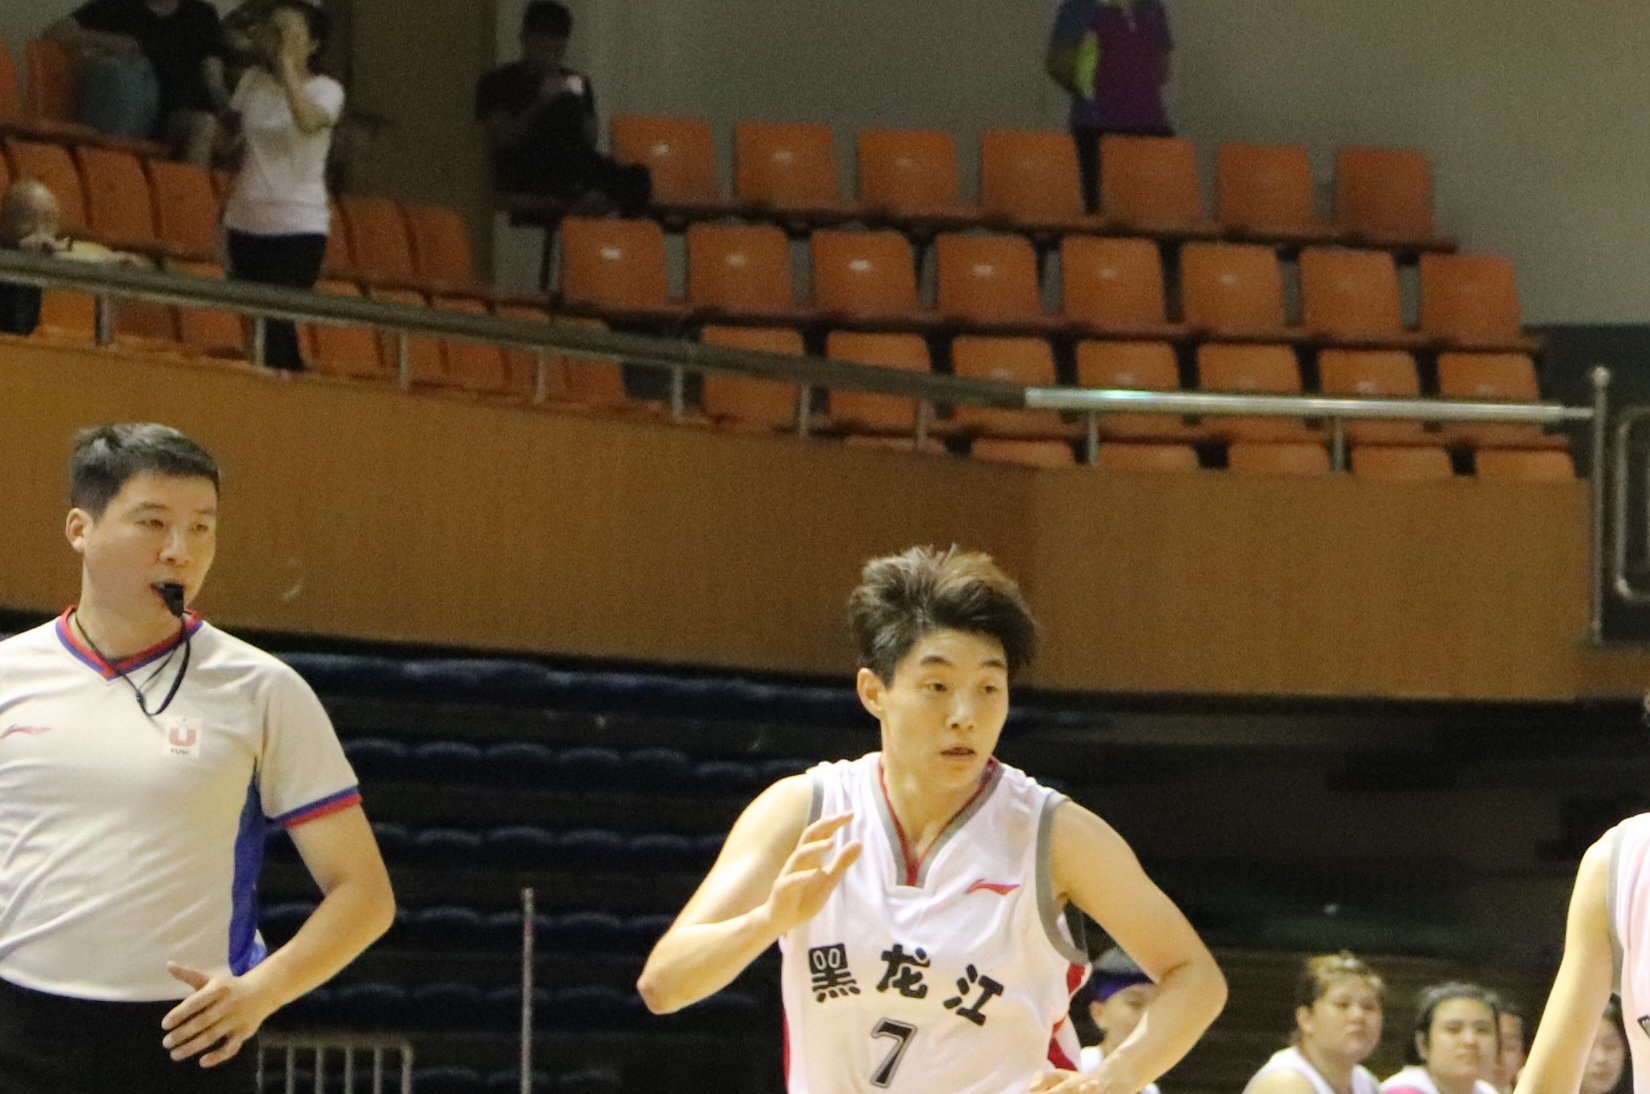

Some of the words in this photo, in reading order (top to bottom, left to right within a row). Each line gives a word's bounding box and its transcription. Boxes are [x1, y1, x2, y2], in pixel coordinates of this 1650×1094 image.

[808, 943, 1004, 1026] 黑龙江
[870, 1017, 918, 1088] 7
